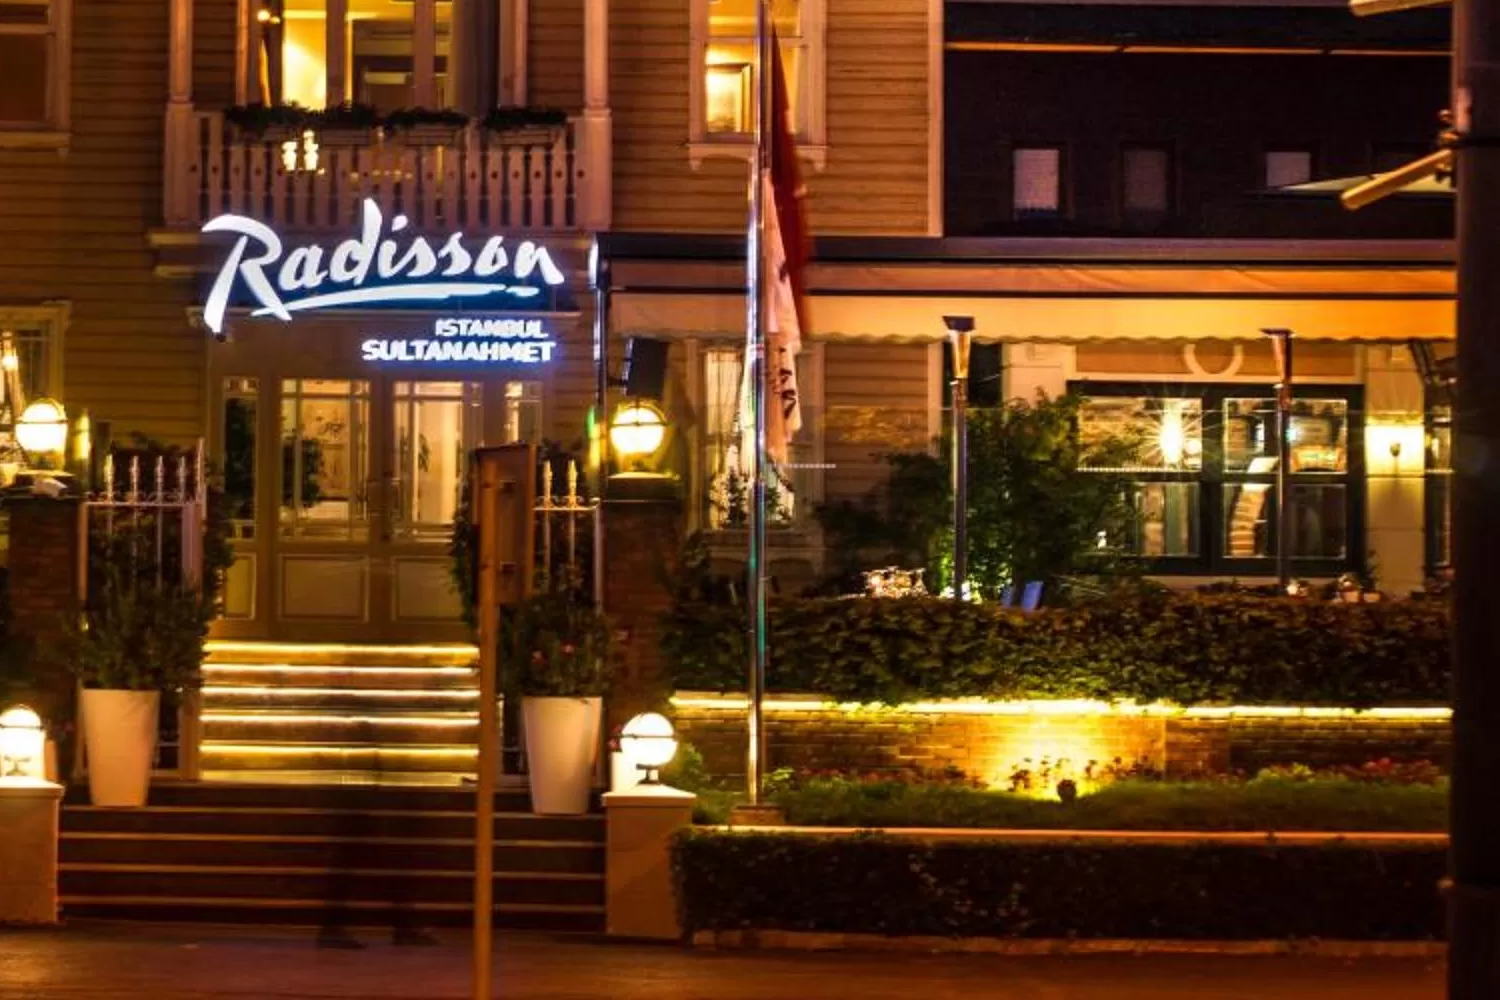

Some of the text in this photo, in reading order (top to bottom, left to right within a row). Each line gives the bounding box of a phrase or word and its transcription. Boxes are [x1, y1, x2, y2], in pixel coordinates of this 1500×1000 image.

[202, 197, 565, 334] Radisson
[434, 317, 549, 339] ISTANBUL
[361, 339, 557, 363] SULTANAHMET
